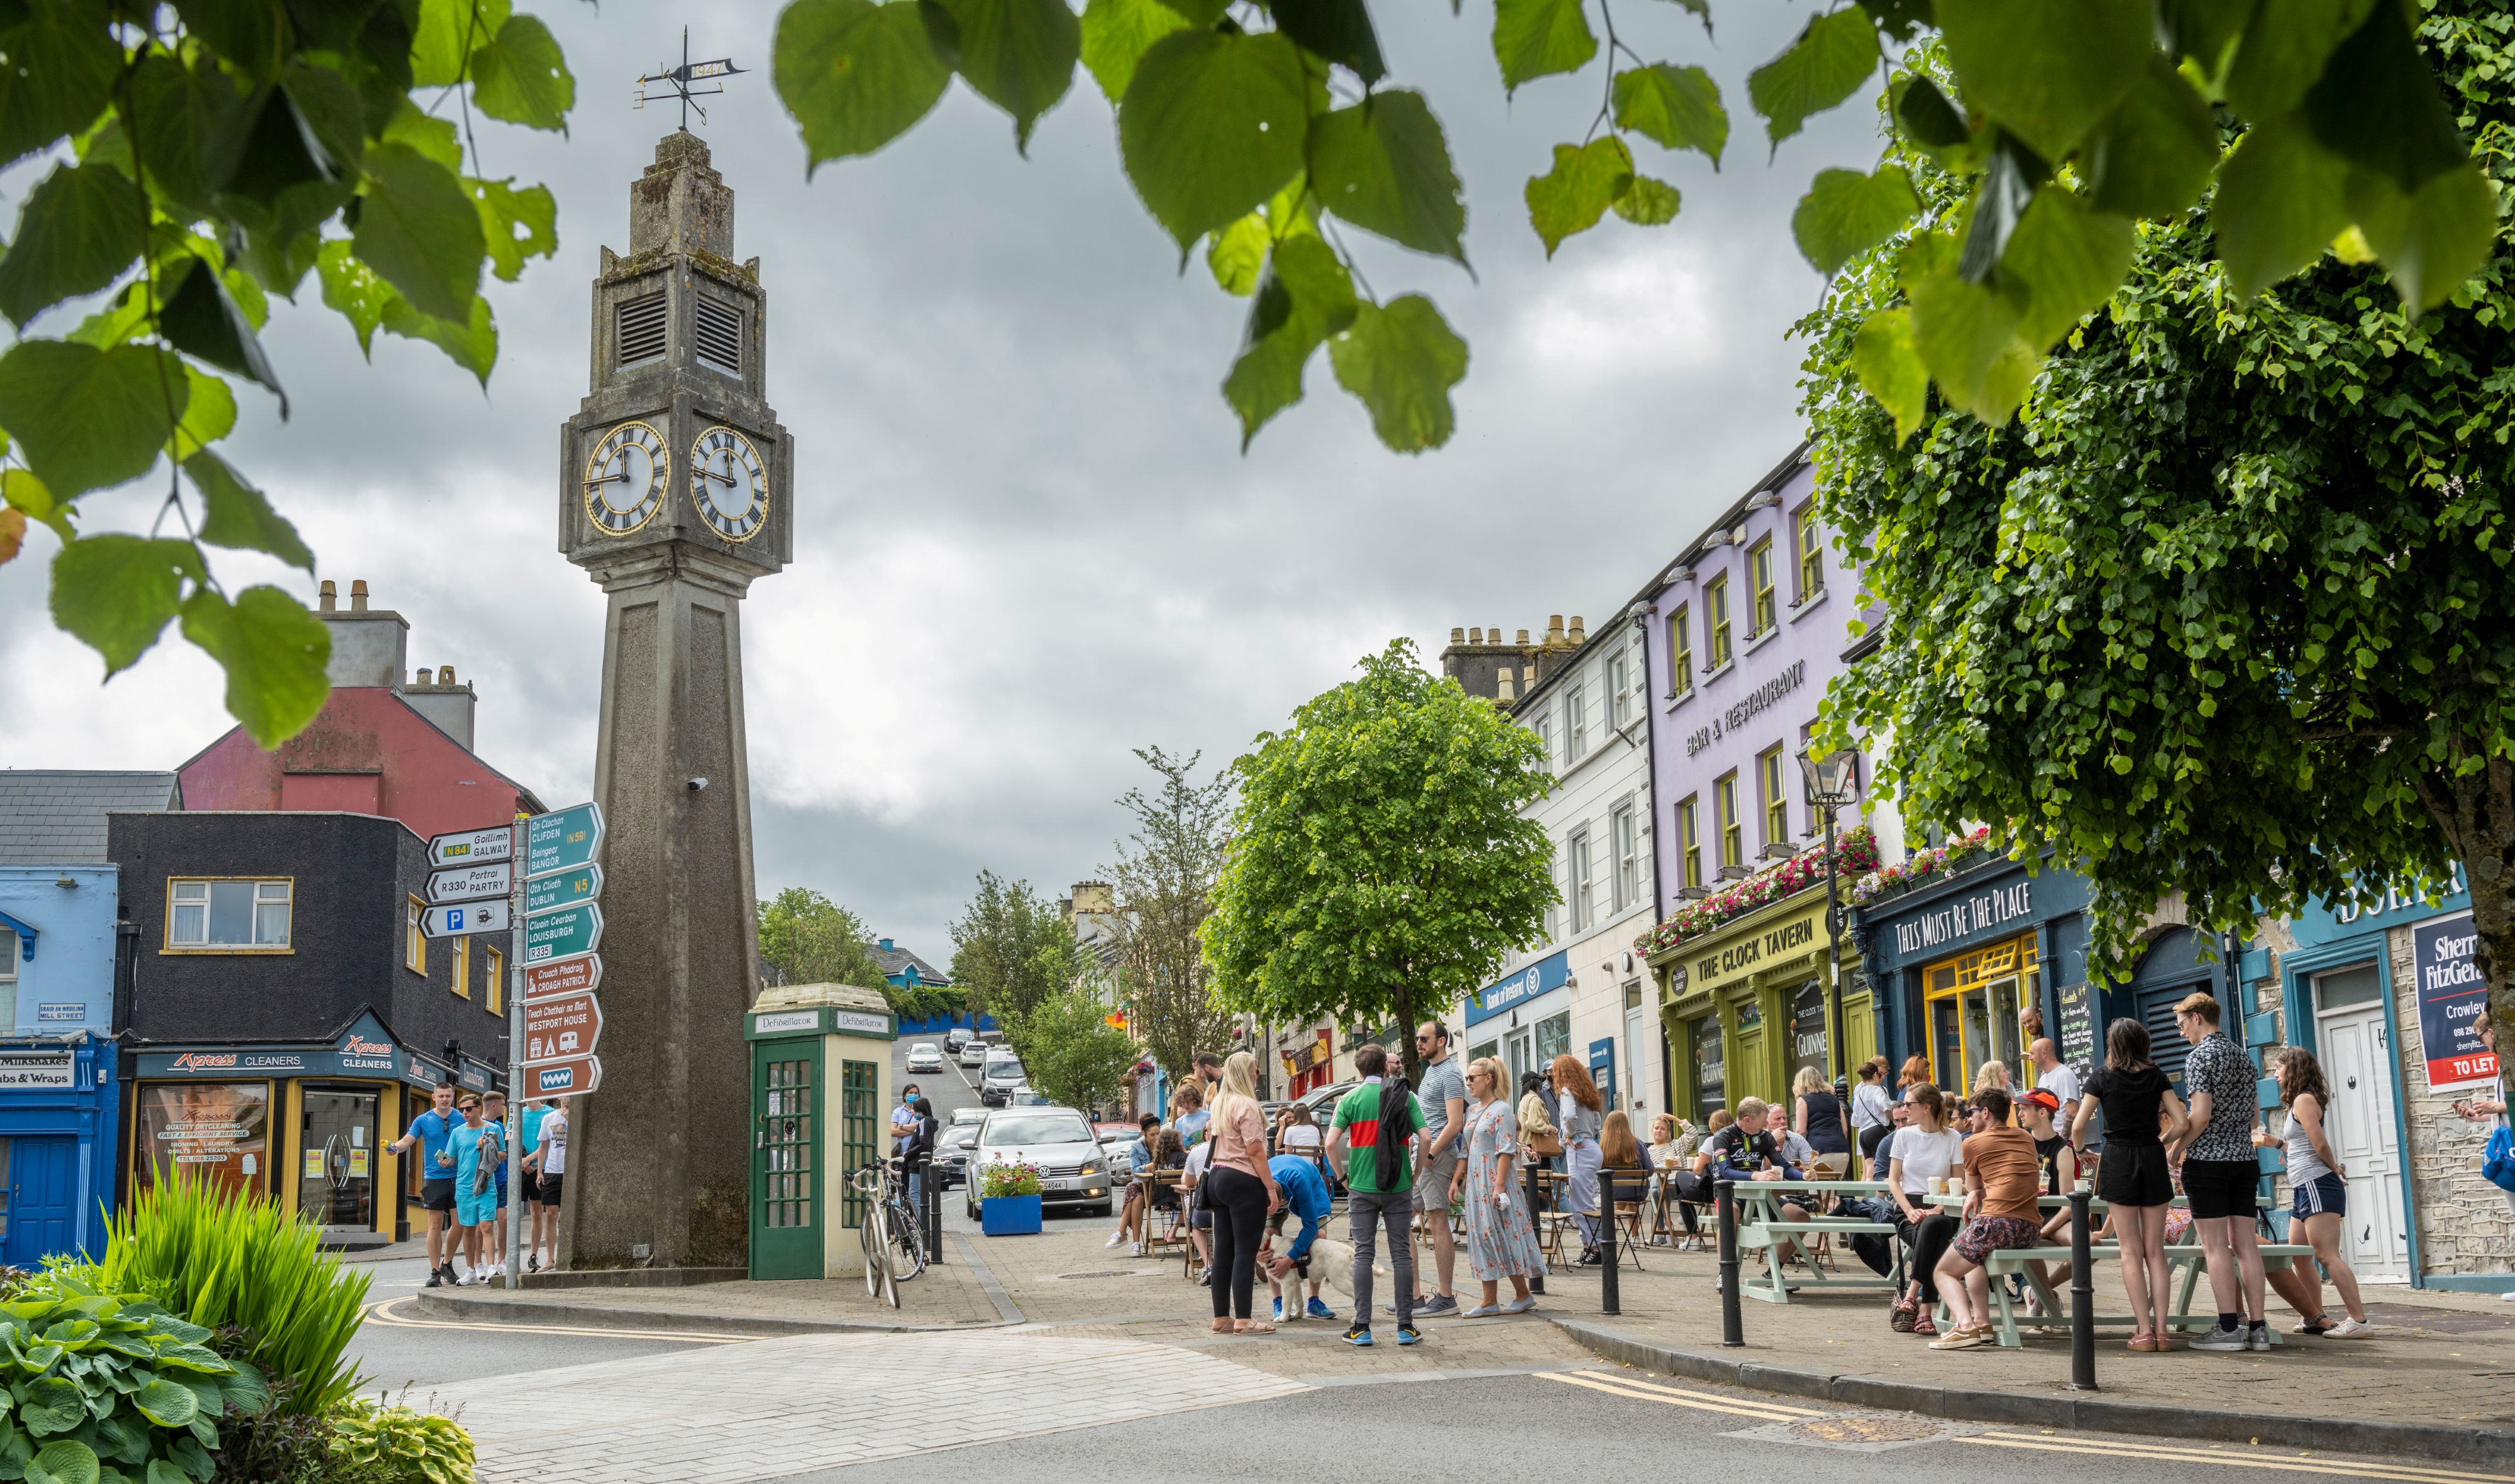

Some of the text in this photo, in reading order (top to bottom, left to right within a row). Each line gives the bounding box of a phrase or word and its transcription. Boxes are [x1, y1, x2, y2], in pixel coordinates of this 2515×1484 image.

[1687, 659, 1805, 757] BAR & RESTAURANT
[474, 832, 508, 844] Gaillimh
[532, 828, 561, 843] CLIFDEN
[474, 844, 508, 857] GALWAY
[532, 846, 559, 859] Baingear
[532, 856, 560, 871] BANGOR
[470, 881, 505, 893] PARTRY
[530, 878, 561, 894] Áth Cliath
[530, 893, 555, 907] DUBLIN
[529, 919, 549, 931] Cluain
[1895, 882, 2032, 955] THIS MUST BE THE PLACE
[529, 926, 574, 943] LOUISBURGH
[1698, 918, 1813, 982] THE CLOCK TAVERN
[2436, 934, 2478, 963] Sherr
[538, 969, 558, 980] Cruach
[538, 974, 586, 993] CROAGH PATRICK
[1676, 981, 1684, 991] BAR
[1487, 977, 1524, 1011] Bank of Ireland
[528, 1001, 587, 1020] Teach Chathair na Mart
[1797, 1004, 1825, 1018] THE CLOCK TAV
[528, 1013, 587, 1032] WESTPORT HOUSE
[763, 1018, 811, 1028] Defibrillator
[843, 1014, 883, 1028] Defibrillator
[2453, 1027, 2465, 1038] 098
[344, 1035, 392, 1058] Xpress
[1797, 1030, 1827, 1058] GUINNE
[174, 1053, 301, 1072] Xpress CLEANERS
[343, 1058, 392, 1070] CLEANERS
[2453, 1057, 2495, 1075] TO LET
[18, 1074, 28, 1083] &
[30, 1074, 68, 1084] Wraps
[1701, 1061, 1725, 1084] GUINNE
